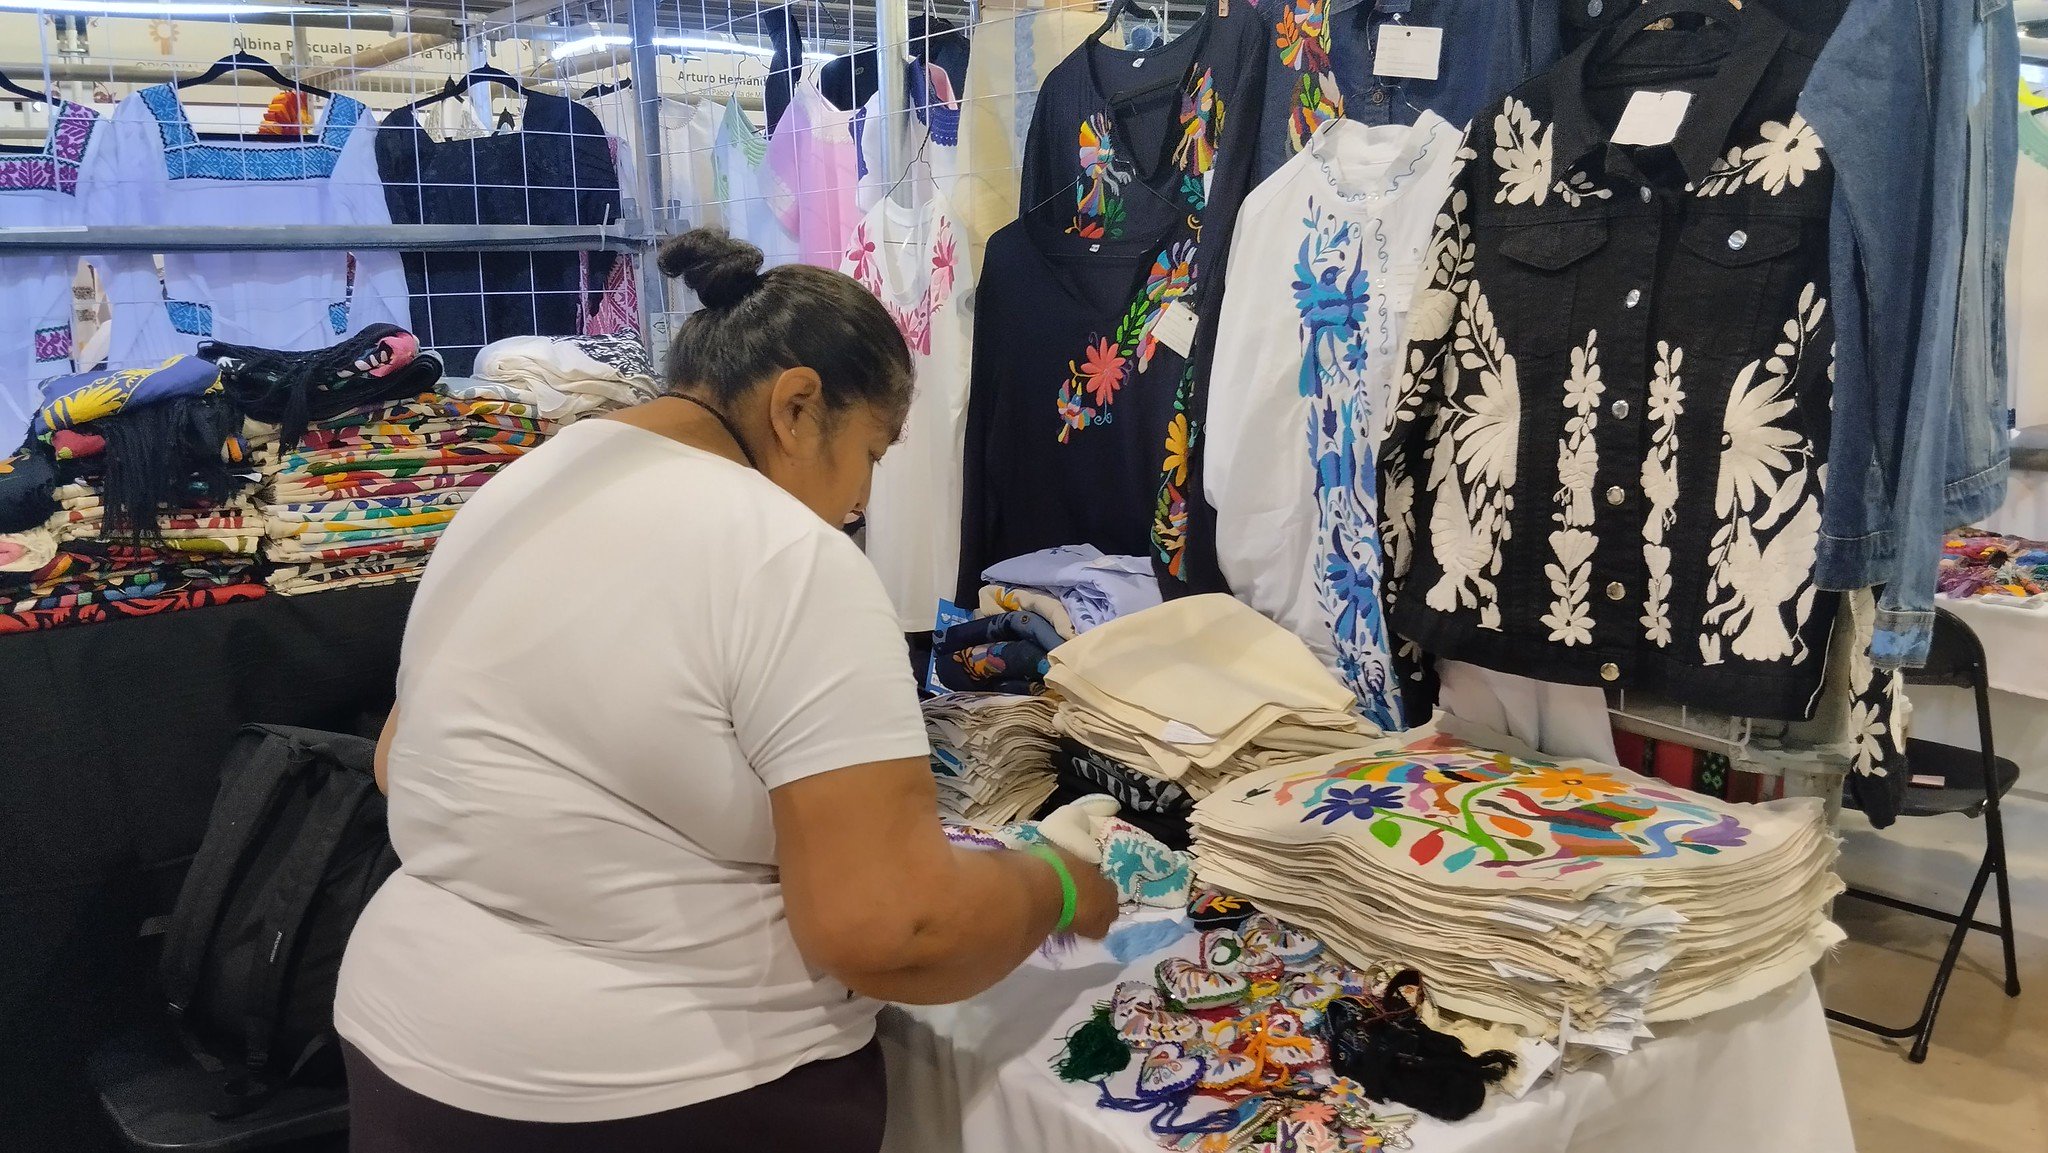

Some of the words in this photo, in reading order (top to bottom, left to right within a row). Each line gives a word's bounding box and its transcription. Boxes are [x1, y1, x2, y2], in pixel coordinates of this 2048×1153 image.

[233, 37, 281, 50] Albina
[286, 40, 352, 54] Pscuala
[437, 49, 465, 61] Torr
[678, 71, 716, 83] Arturo
